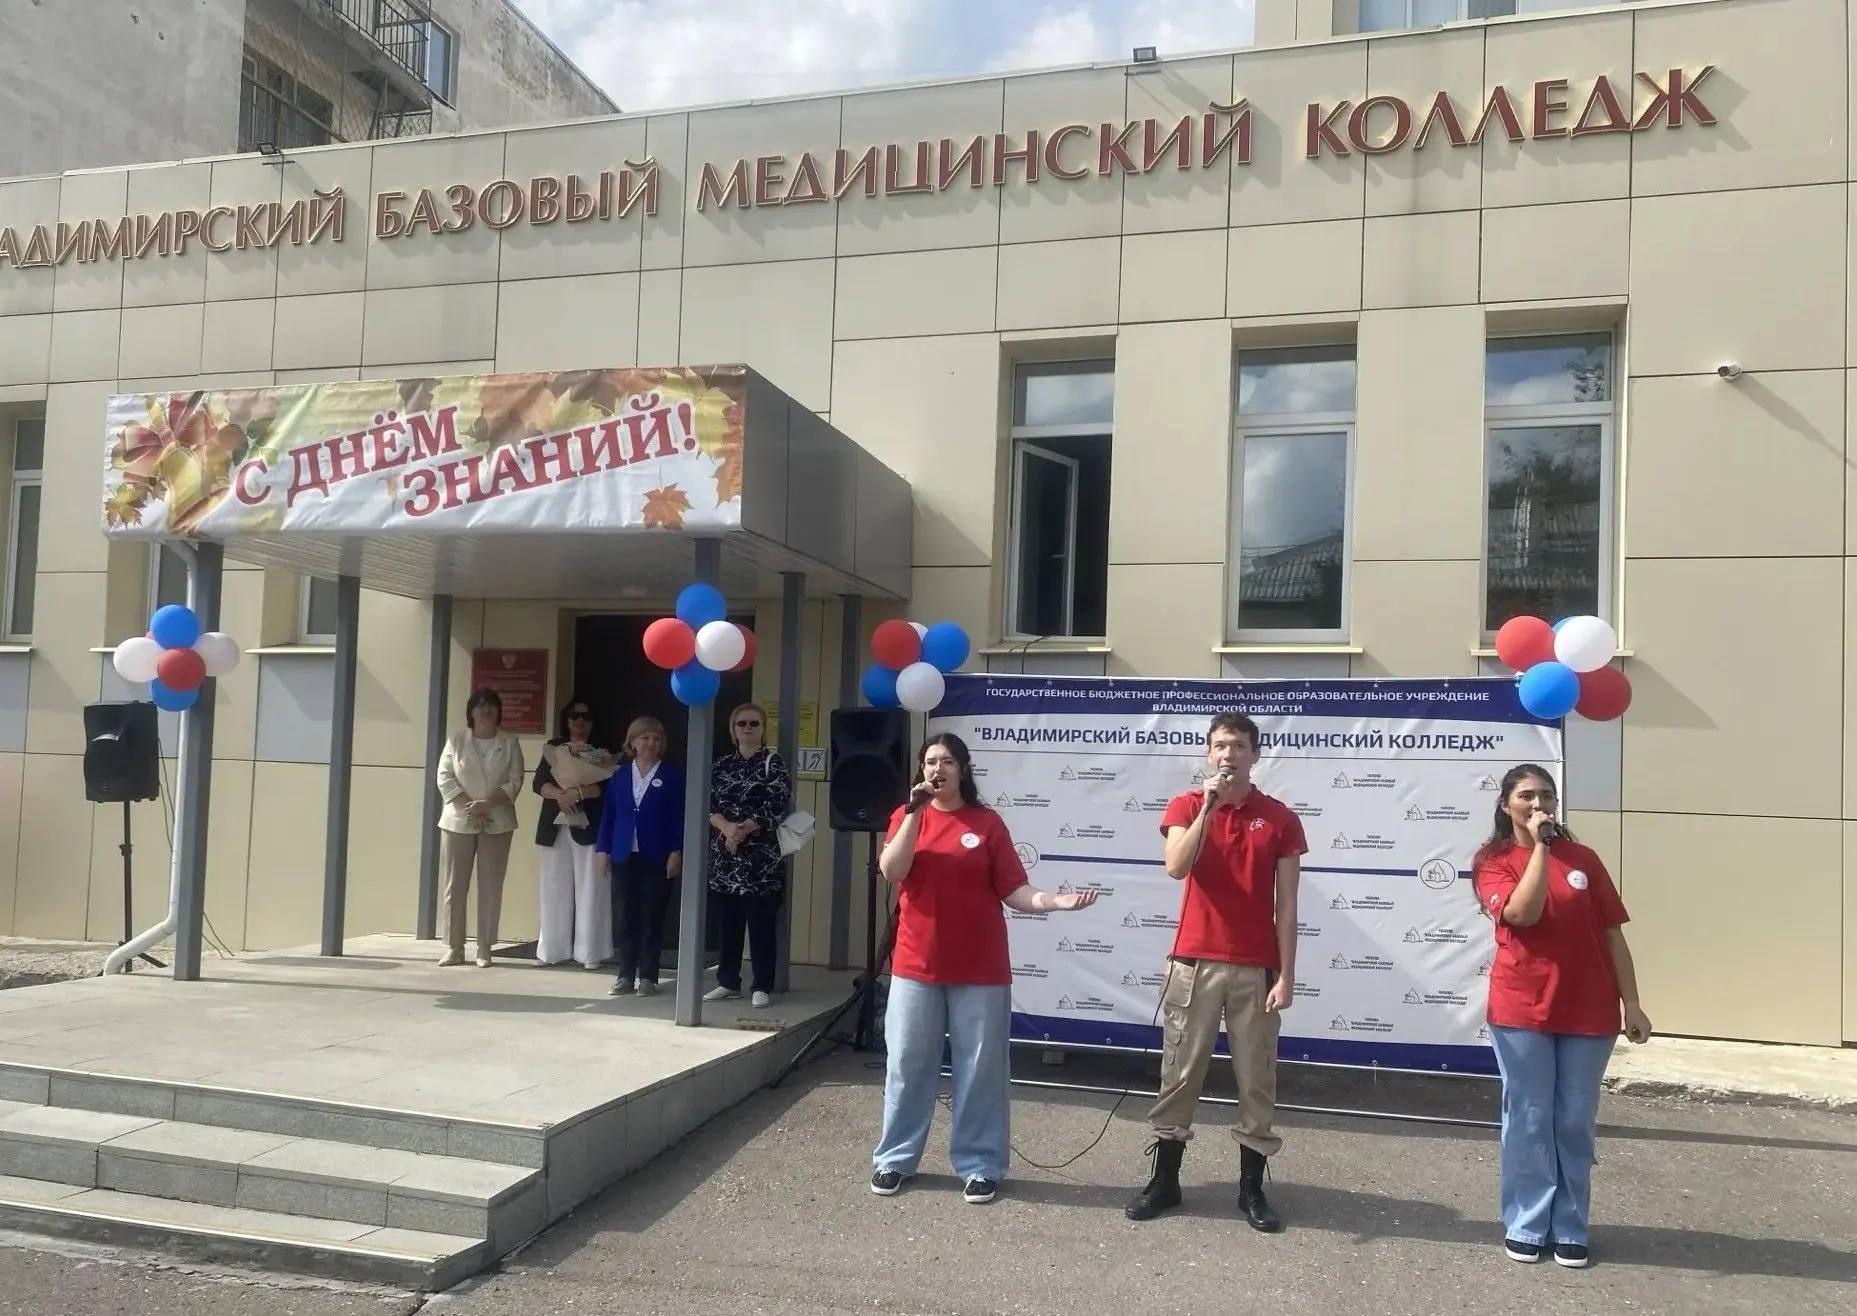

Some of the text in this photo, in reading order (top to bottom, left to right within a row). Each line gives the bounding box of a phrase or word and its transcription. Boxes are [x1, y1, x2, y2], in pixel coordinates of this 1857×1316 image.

[0, 64, 1719, 269] АДИМИРСКИЙ БАЗОВЫЙ МЕДИЦИНСКИЙ КОЛЛЕДЖ
[236, 406, 462, 508] С ДНЁМ
[403, 394, 698, 517] ЗНАНИЙ!
[986, 688, 1490, 702] ГОСУДАРСТВЕННОЕ БЮДЖЕТНОЕ ПРОФЕССИОНАЛЬНОЕ ОБРАЗОВАТЕЛЬНОЕ УЧРЕЖДЕНИЕ
[1152, 703, 1303, 713] ВЛАДИМИРСКОЙ ОБЛАСТИ
[974, 726, 1504, 752] "ВЛАДИМИРСКИЙ БАЗОВЫ ДИЦИНСКИЙ КОЛЛЕДЖ"
